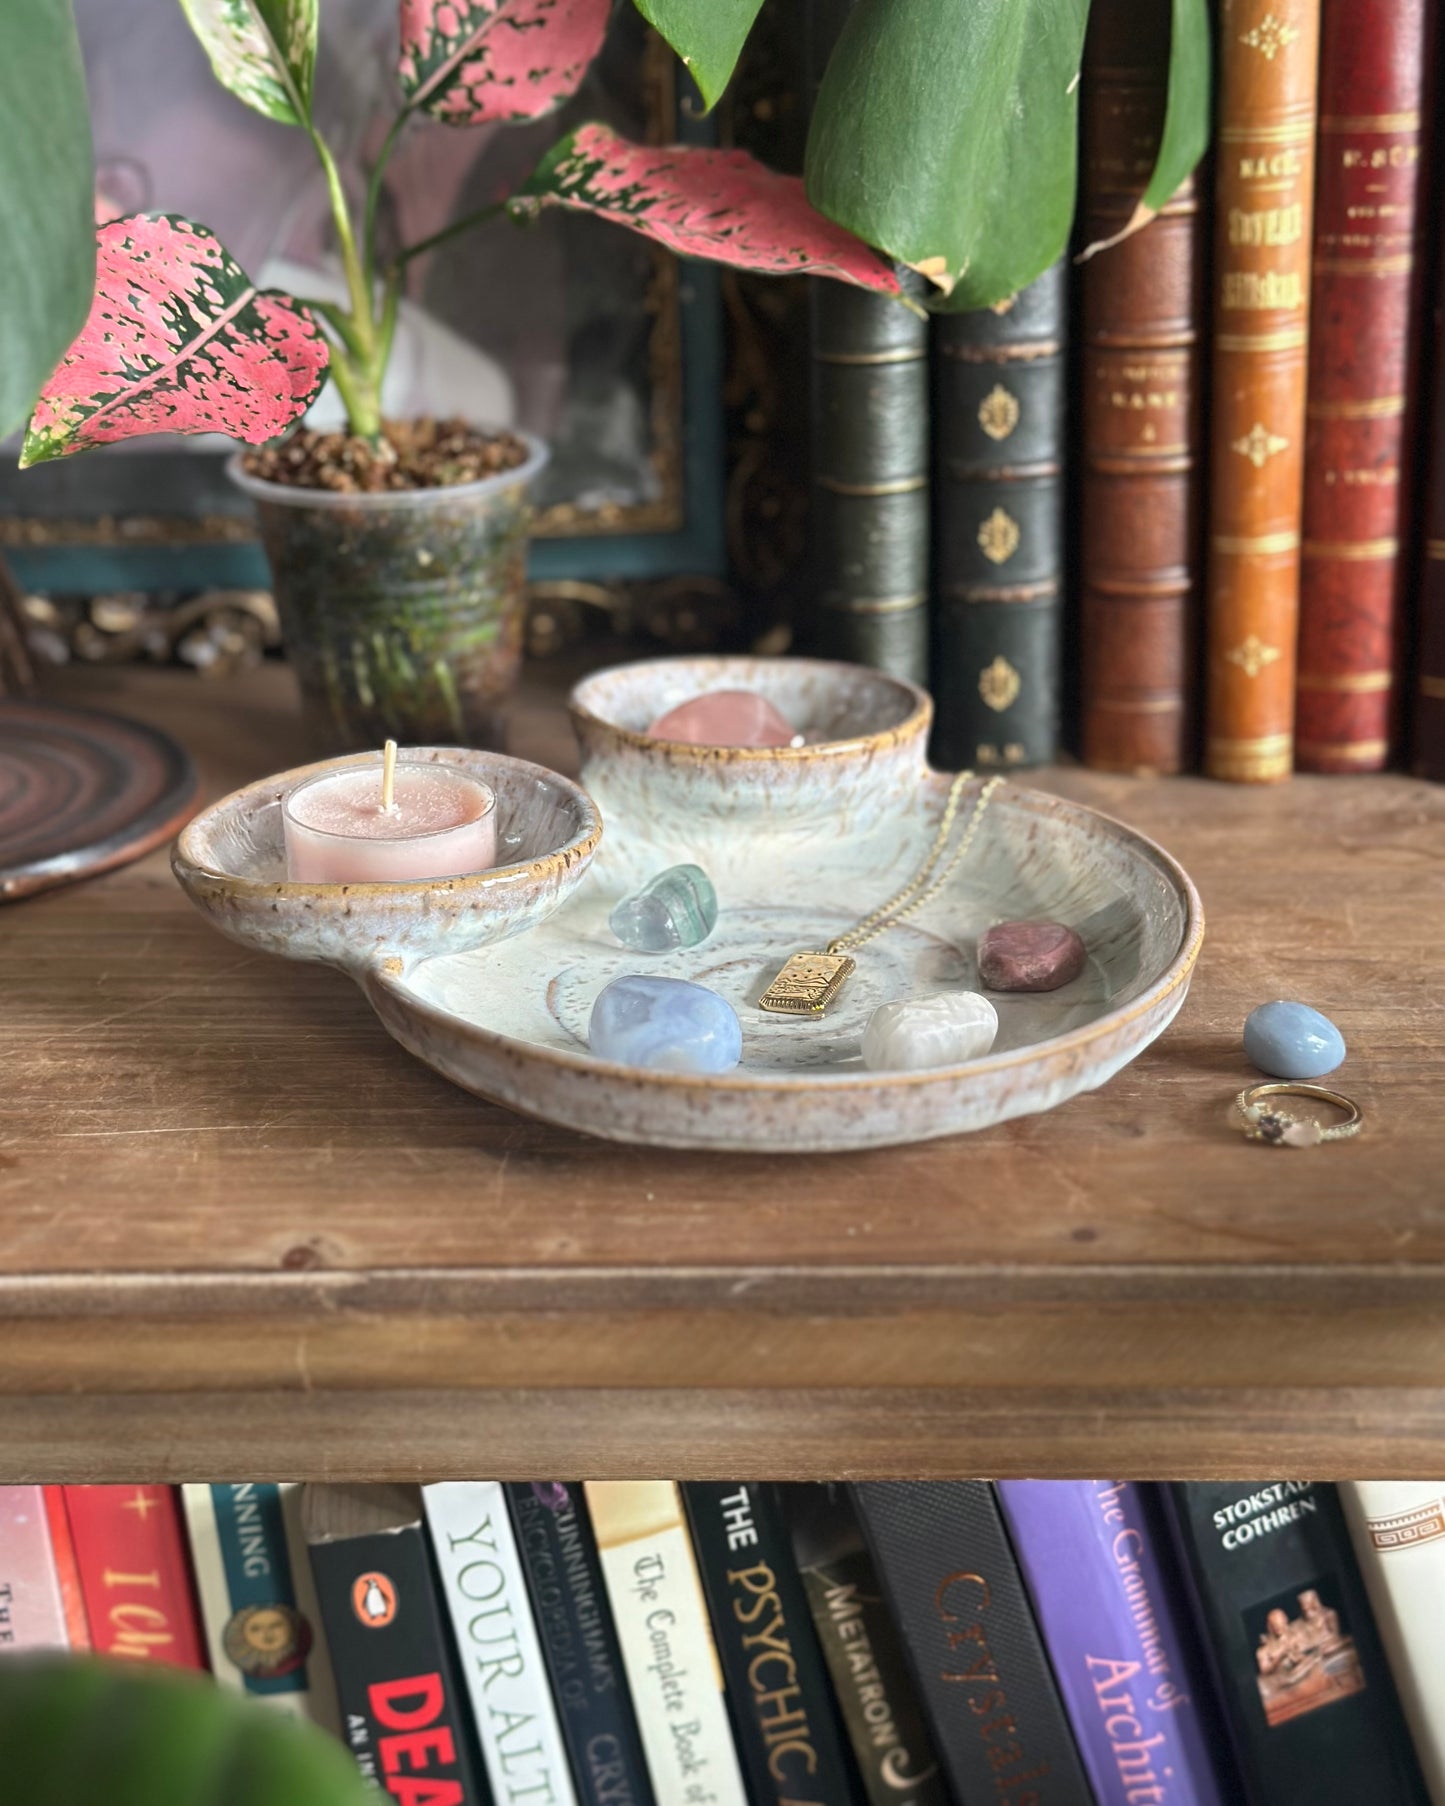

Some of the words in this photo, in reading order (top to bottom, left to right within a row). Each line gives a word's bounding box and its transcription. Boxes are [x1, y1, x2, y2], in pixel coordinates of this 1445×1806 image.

[720, 1486, 758, 1551] THE
[1222, 1496, 1317, 1551] COTHREN
[631, 1553, 665, 1602] The
[1093, 1480, 1126, 1525] he
[1113, 1528, 1170, 1674] Grammar
[1147, 1681, 1190, 1711] of
[447, 1513, 525, 1693] YOUR
[488, 1704, 556, 1804] ALT
[645, 1608, 687, 1711] Complete
[727, 1560, 818, 1783] PSYCHIC
[825, 1584, 898, 1747] METATRON
[346, 1714, 368, 1746] AN
[586, 1733, 637, 1806] CRY
[670, 1717, 708, 1779] Book
[1085, 1653, 1174, 1806] Archit
